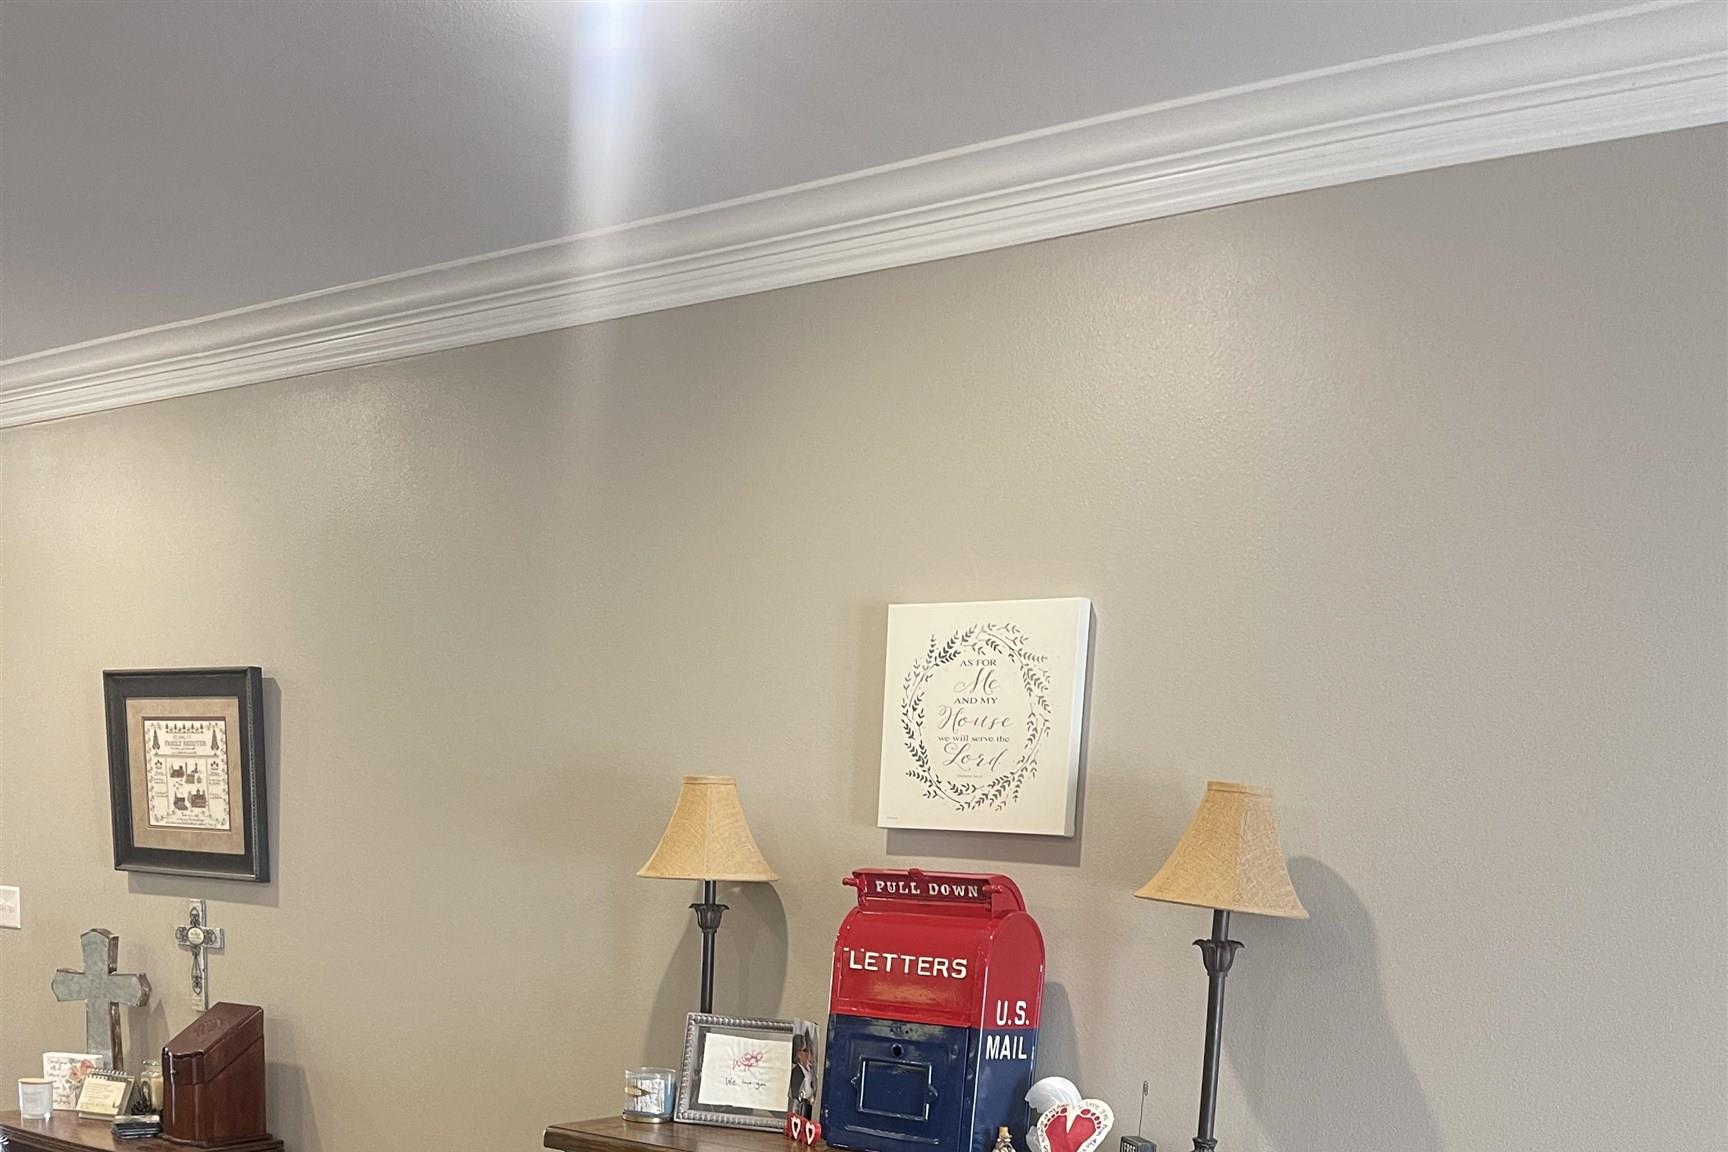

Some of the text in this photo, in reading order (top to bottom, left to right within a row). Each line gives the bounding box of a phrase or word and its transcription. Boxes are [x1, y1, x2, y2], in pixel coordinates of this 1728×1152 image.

[960, 658, 997, 668] AS FOR
[953, 667, 1000, 696] Me
[953, 696, 998, 705] AND MY
[937, 704, 1014, 735] House
[952, 734, 969, 742] will
[971, 735, 994, 743] serve
[996, 735, 1010, 743] the
[942, 742, 1009, 773] Lord
[875, 880, 979, 898] PULL DOWN
[848, 949, 968, 980] LETTERS
[996, 1000, 1030, 1026] U.S.
[985, 1034, 1028, 1060] MAIL
